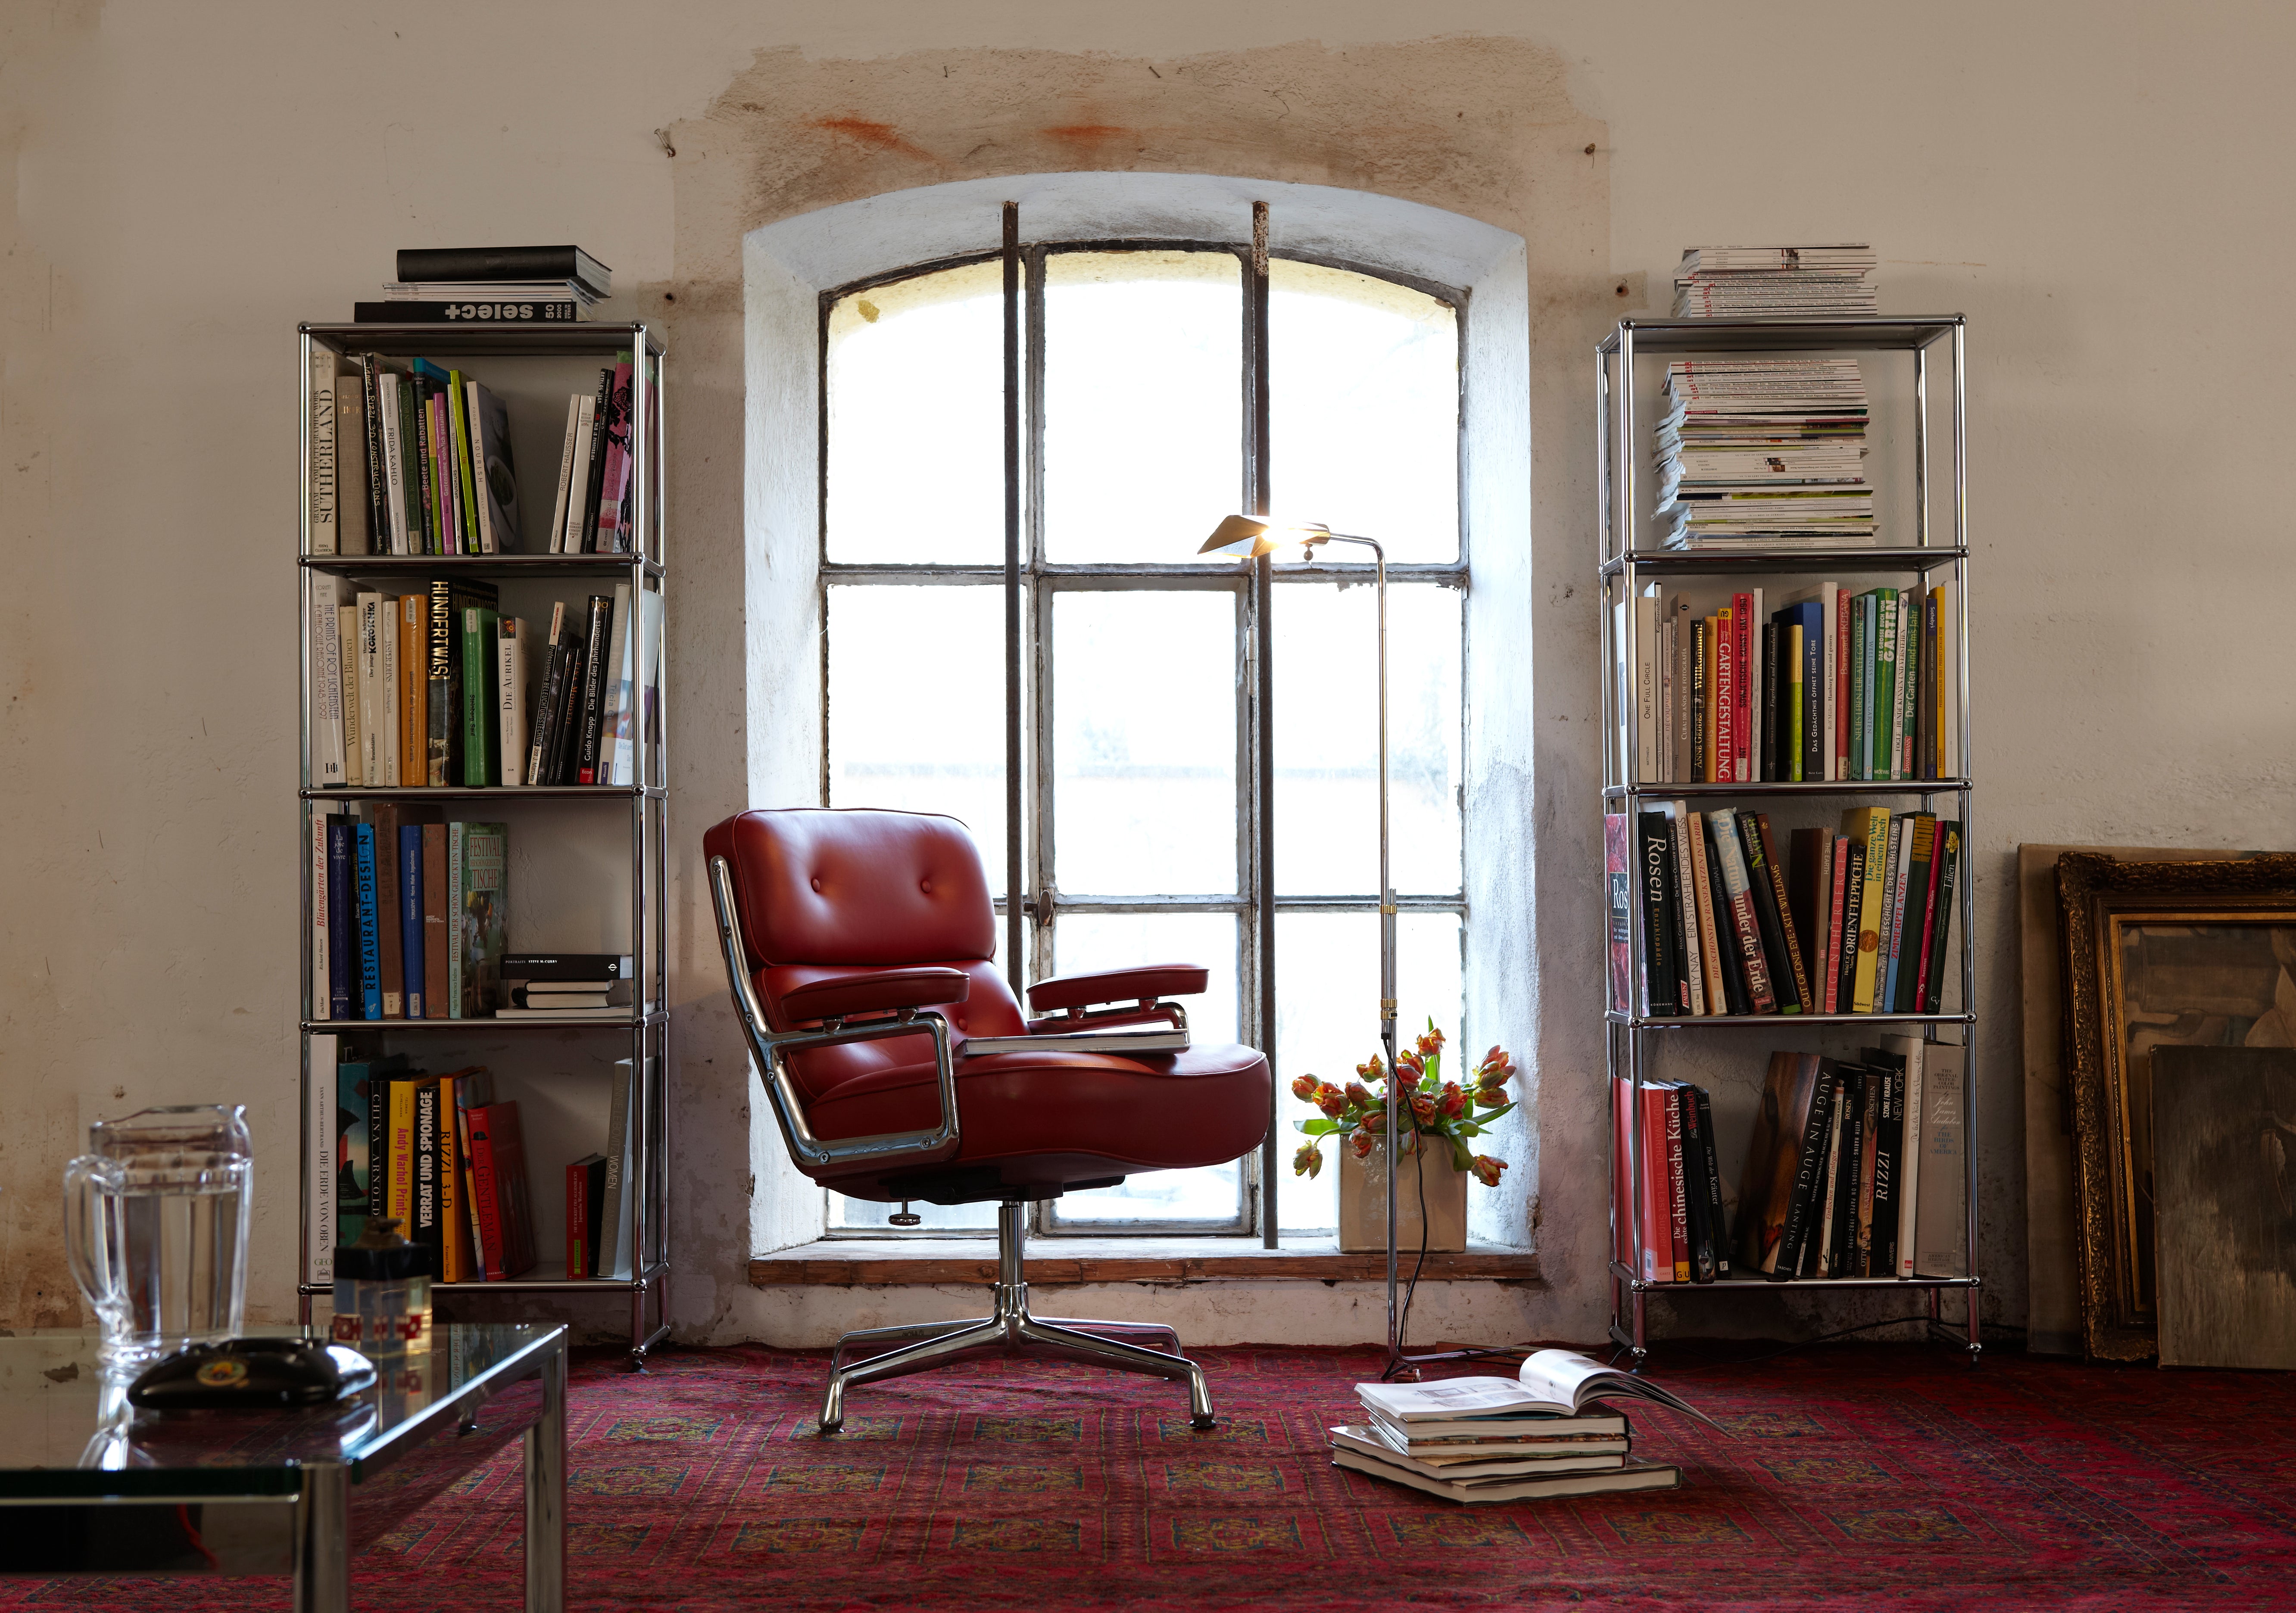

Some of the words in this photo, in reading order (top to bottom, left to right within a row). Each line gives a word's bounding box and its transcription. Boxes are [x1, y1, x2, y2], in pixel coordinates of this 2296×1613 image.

[546, 304, 555, 319] 50
[418, 409, 426, 446] Rabatten
[319, 389, 333, 523] SUTHERLAND
[564, 433, 573, 463] HAUSSER
[421, 467, 429, 490] Beete
[325, 604, 334, 615] THE
[326, 618, 336, 641] PRINTS
[592, 620, 601, 664] Jahrhunderts
[1884, 600, 1896, 662] GARTEN
[327, 643, 336, 656] OF
[344, 639, 353, 673] Blumen
[327, 659, 337, 675] ROY
[503, 645, 512, 687] AURIKEL
[544, 646, 555, 681] Professionelle
[345, 676, 354, 689] der
[328, 678, 339, 719] LICHTENSTEIN
[503, 692, 513, 710] DIE
[1719, 643, 1731, 778] GARTENGESTALTUNG
[346, 691, 356, 746] Wunderwelt
[535, 682, 549, 746] BELEUCHTUNGSTECHNIK
[586, 717, 596, 738] Knopp
[315, 819, 324, 853] Zukunft
[1717, 818, 1729, 840] Die
[1869, 815, 1878, 835] Welt
[1877, 818, 1886, 841] Buch
[1912, 816, 1935, 855] NATUR
[470, 837, 501, 856] FESTIVAL
[1747, 818, 1766, 870] NATUR
[1868, 837, 1877, 863] ganze
[1875, 844, 1884, 871] einem
[315, 856, 324, 869] der
[1647, 835, 1667, 902] Rosen
[1865, 865, 1873, 881] Die
[1944, 864, 1955, 888] Lilien
[473, 869, 498, 888] TISCHE
[1713, 866, 1724, 901] TWILIGHT
[1724, 844, 1750, 933] Naturwunder
[1771, 864, 1788, 910] WILLIAMS
[1873, 873, 1881, 881] in
[317, 873, 327, 927] Blütengärten
[359, 835, 376, 990] RESTAURANT-DESIGN
[1782, 911, 1793, 928] KIT
[1828, 845, 1847, 1006] JUGENDHERBERGEN
[1891, 873, 1907, 959] ZIMMERPFLANZEN
[1653, 908, 1662, 966] Enzyklopädie
[1743, 936, 1756, 957] der
[1788, 934, 1797, 949] EYE
[1792, 951, 1802, 971] ONE
[1747, 958, 1766, 992] Erde
[1797, 972, 1806, 985] OF
[1800, 987, 1811, 1007] OUT
[1814, 1072, 1831, 1115] AUGE
[1894, 1068, 1904, 1093] YORK
[1893, 1098, 1903, 1121] NEW
[1932, 1106, 1956, 1117] James
[1934, 1096, 1953, 1108] John
[420, 1092, 433, 1151] SPIONAGE
[1666, 1095, 1681, 1140] Küche
[1809, 1122, 1819, 1140] IN
[395, 1128, 409, 1150] Andy
[441, 1130, 451, 1175] RIZZI
[319, 1151, 328, 1168] DIE
[396, 1154, 408, 1185] Warhol
[420, 1155, 432, 1180] UND
[1798, 1147, 1814, 1190] AUGE
[1829, 1151, 1838, 1175] Einlegen
[319, 1171, 328, 1198] ERDE
[1671, 1144, 1687, 1224] chinesische
[1876, 1149, 1890, 1201] RIZZI
[396, 1189, 407, 1216] Prints
[420, 1183, 432, 1228] VERRAT
[442, 1183, 452, 1208] 3-D
[1825, 1189, 1834, 1220] Einkochen
[320, 1201, 328, 1222] VON
[320, 1225, 328, 1252] OBEN
[1787, 1204, 1802, 1249] LANTING
